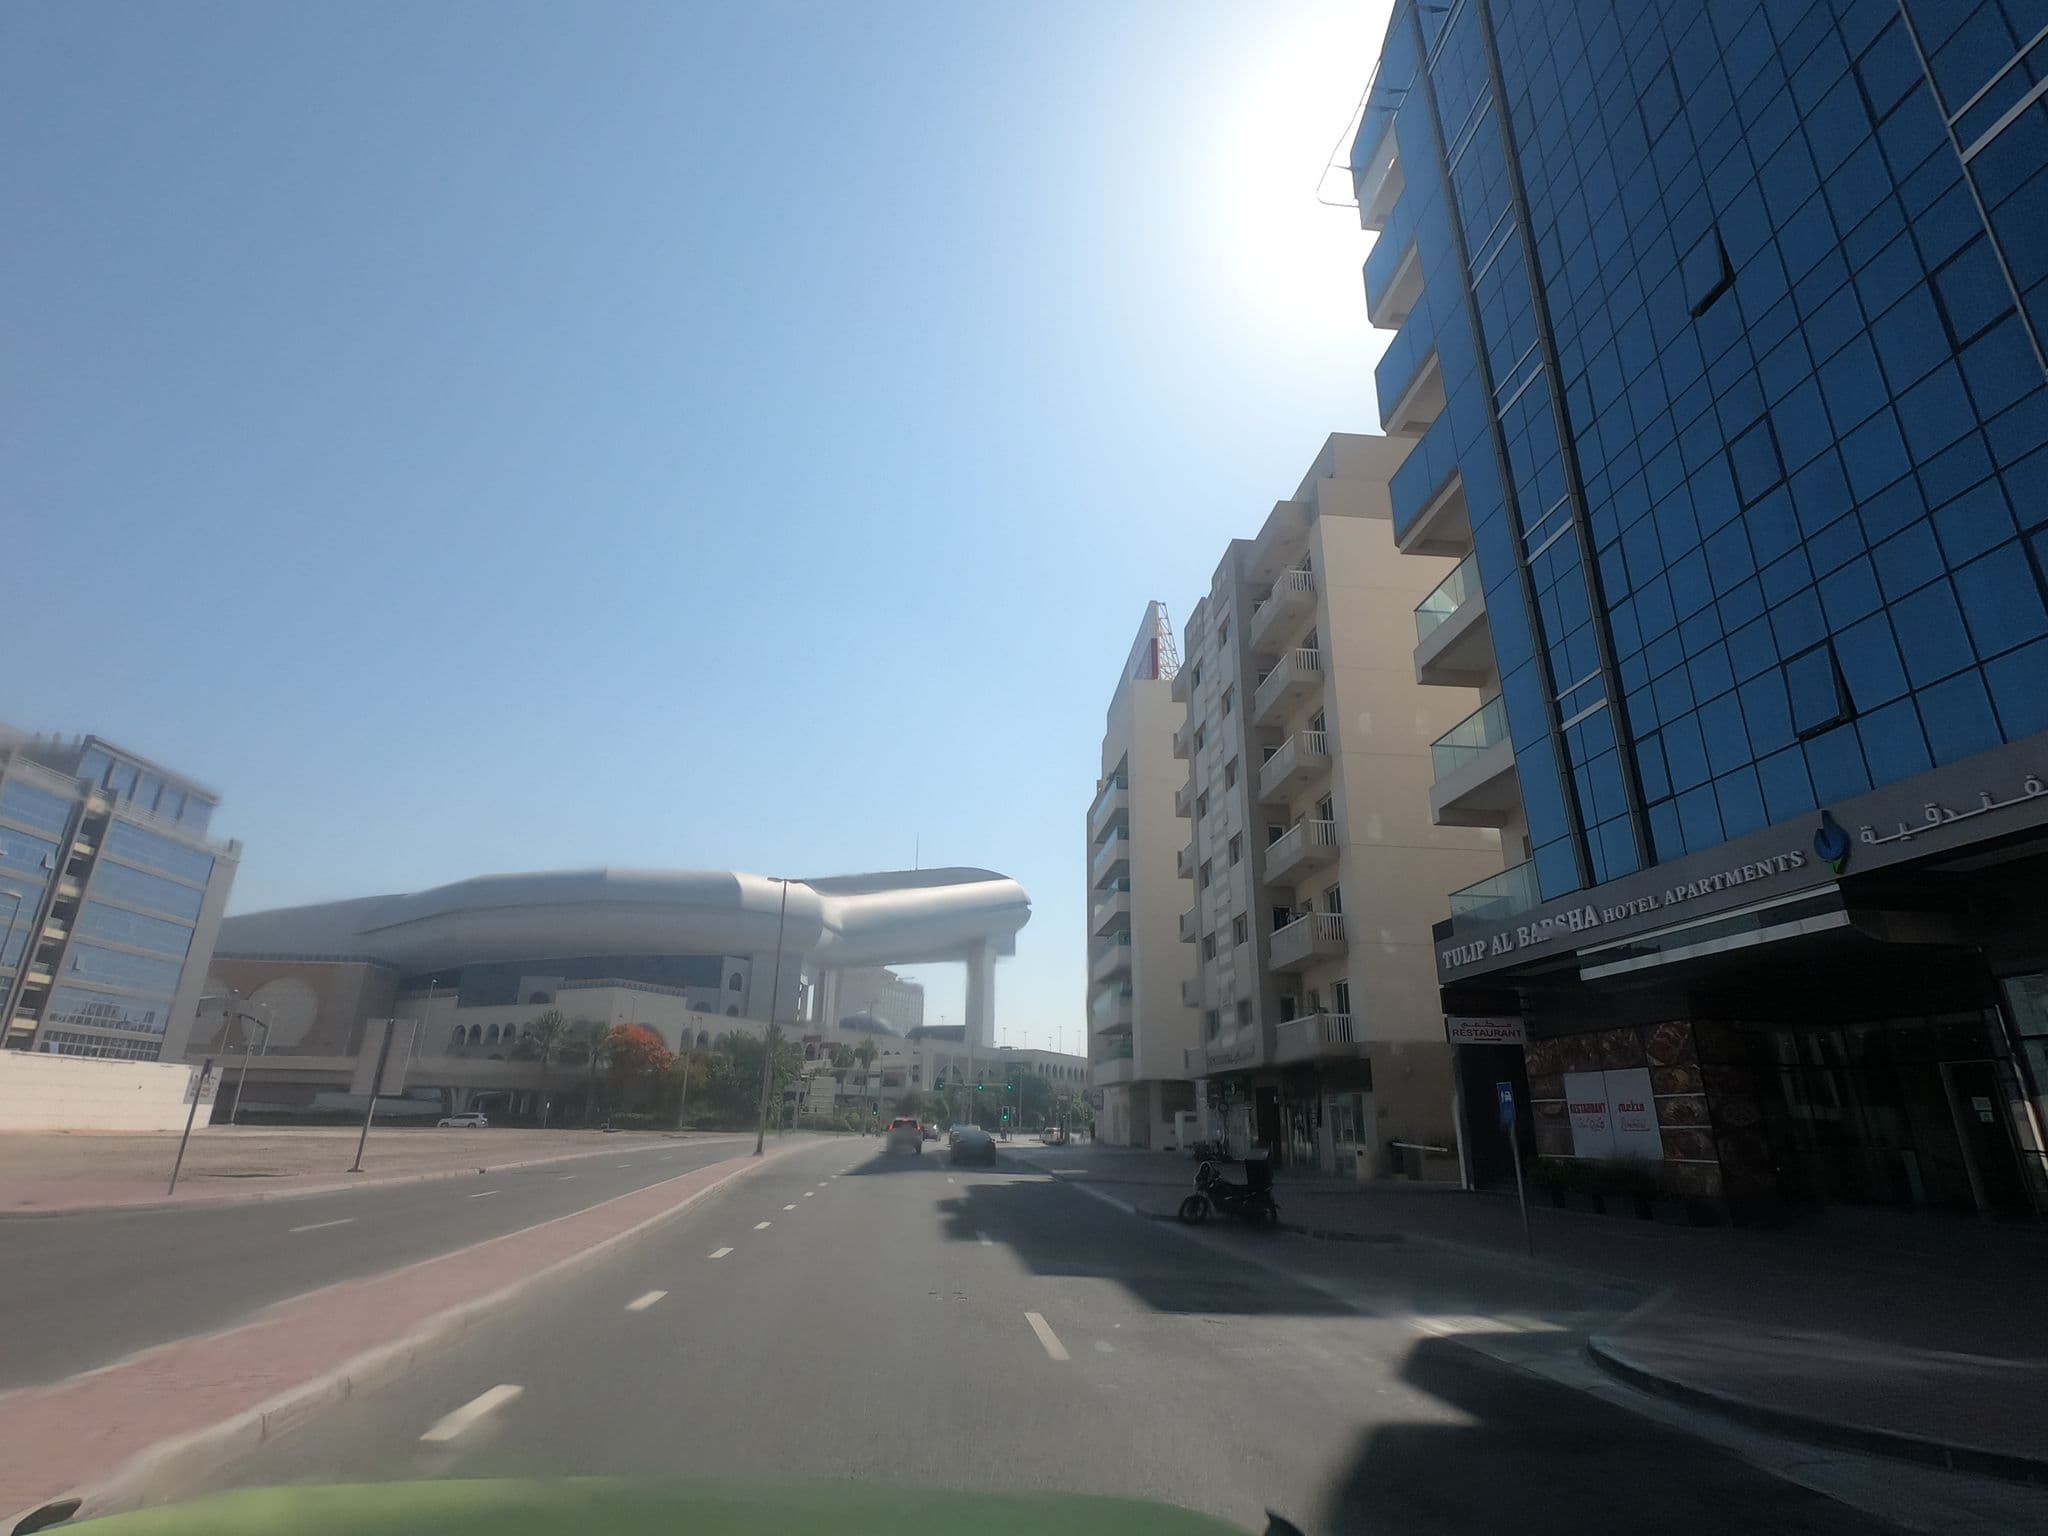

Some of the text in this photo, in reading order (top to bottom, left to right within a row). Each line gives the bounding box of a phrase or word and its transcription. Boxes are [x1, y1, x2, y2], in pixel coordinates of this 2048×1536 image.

[1442, 941, 1489, 969] TULIP
[1491, 933, 1514, 956] AL
[1602, 895, 1661, 924] HOTEL
[1663, 850, 1806, 907] APARTMENTS
[1452, 1028, 1521, 1037] RESTAURANT
